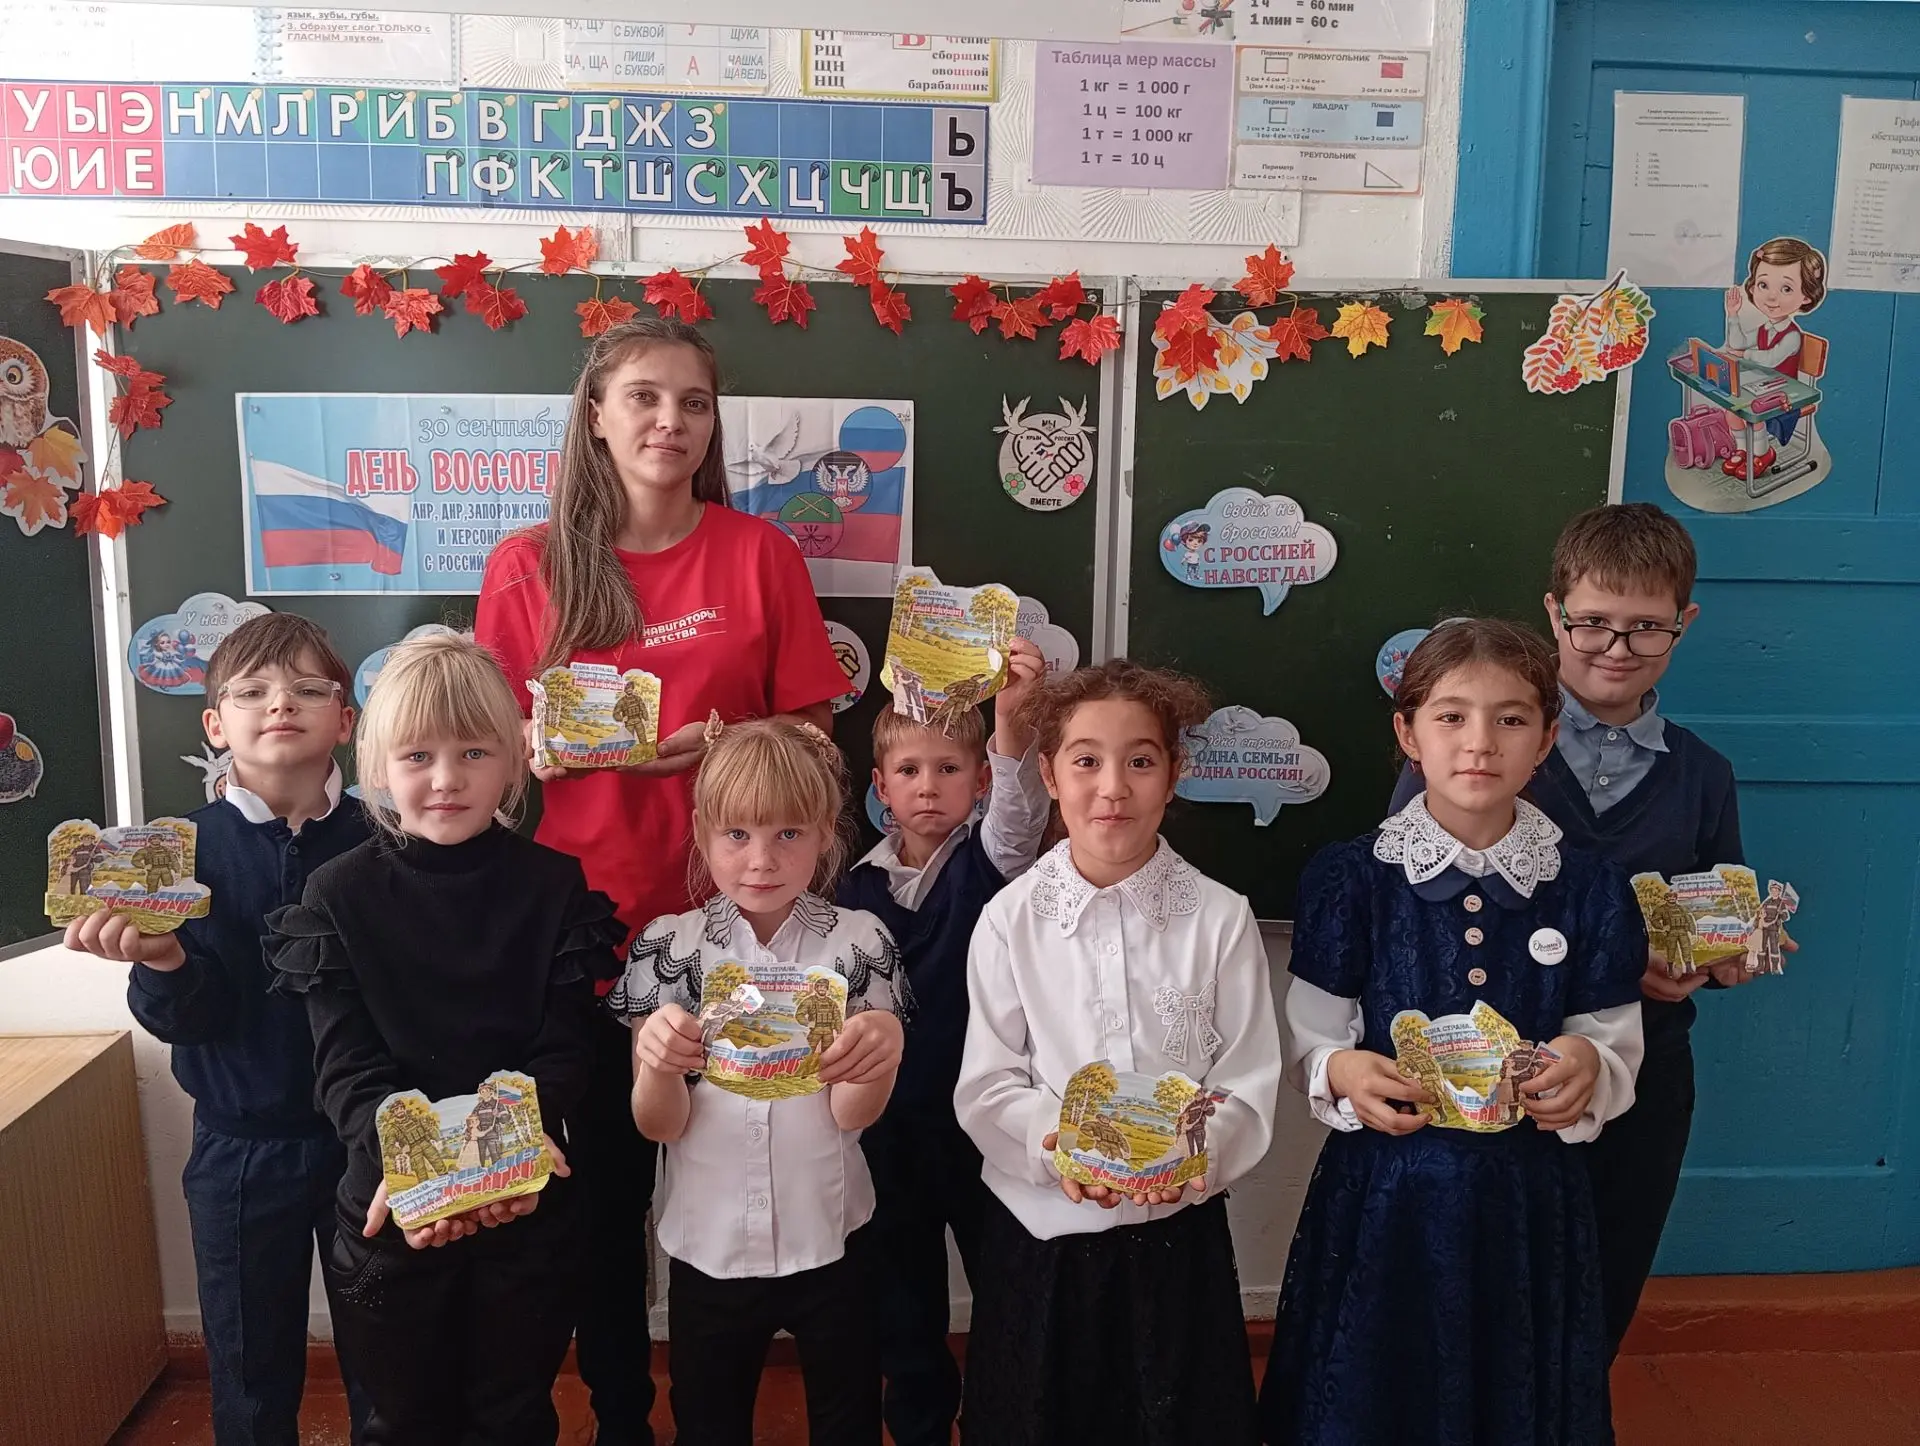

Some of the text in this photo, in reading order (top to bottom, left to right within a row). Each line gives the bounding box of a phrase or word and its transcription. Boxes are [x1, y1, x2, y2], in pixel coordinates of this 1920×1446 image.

[1310, 0, 1325, 10] 60
[1328, 3, 1354, 12] мин
[299, 22, 348, 32] Образует
[379, 24, 421, 33] ТОЛЬКО
[1250, 13, 1259, 25] 1
[1262, 16, 1292, 26] мин
[1311, 15, 1327, 28] 60
[1331, 19, 1339, 28] с
[287, 33, 340, 42] ГЛАСНЫМ
[614, 25, 665, 38] С БУКВОЙ
[730, 28, 760, 40] ЩУКА
[623, 51, 655, 62] ПИШИ
[815, 44, 842, 58] РЩ
[932, 51, 990, 62] сборщик
[1297, 53, 1371, 62] ПРЯМОУГОЛЬНИК
[589, 55, 609, 72] ЩА
[687, 56, 700, 76] А
[728, 54, 764, 66] ЧАШКА
[814, 60, 845, 73] ЩН
[1052, 51, 1216, 69] Таблица мер массы
[615, 64, 665, 77] С БУКВОЙ
[724, 68, 767, 80] ЩАВЕЛЬ
[932, 66, 989, 78] овощной
[814, 75, 845, 88] НЩ
[908, 79, 989, 92] барабанщик
[1080, 79, 1089, 92] 1
[1094, 82, 1109, 93] кг
[1184, 84, 1191, 94] г
[1083, 103, 1092, 116] 1
[1096, 106, 1107, 119] ц
[1135, 105, 1162, 118] 100
[1167, 108, 1183, 118] кг
[1312, 102, 1349, 111] КВАДРАТ
[1082, 127, 1091, 140] 1
[1096, 130, 1104, 140] т
[1178, 132, 1193, 143] кг
[1081, 151, 1090, 164] 1
[1095, 153, 1103, 164] т
[1131, 153, 1149, 165] 10
[1154, 155, 1164, 168] ц
[1300, 151, 1357, 160] ТРЕУГОЛЬНИК
[419, 418, 450, 443] 30
[347, 450, 418, 495] ДЕНЬ
[1030, 497, 1062, 507] ВМЕСТЕ
[412, 503, 438, 520] ЛНР,
[1222, 501, 1297, 518] Своих не
[438, 529, 445, 545] И
[1221, 521, 1301, 543] бросаем!
[1204, 539, 1316, 563] С РОССИЕЙ
[425, 555, 432, 571] С
[1204, 565, 1316, 586] НАВСЕГДА!
[201, 614, 228, 627] нас
[643, 609, 717, 637] НАВИГАТОРЫ
[645, 627, 698, 648] ДЕТСТВА
[1240, 737, 1296, 750] страна!
[1196, 751, 1300, 765] ОДНА СЕМЬЯ!
[1192, 766, 1304, 781] ОДНА РОССИЯ!
